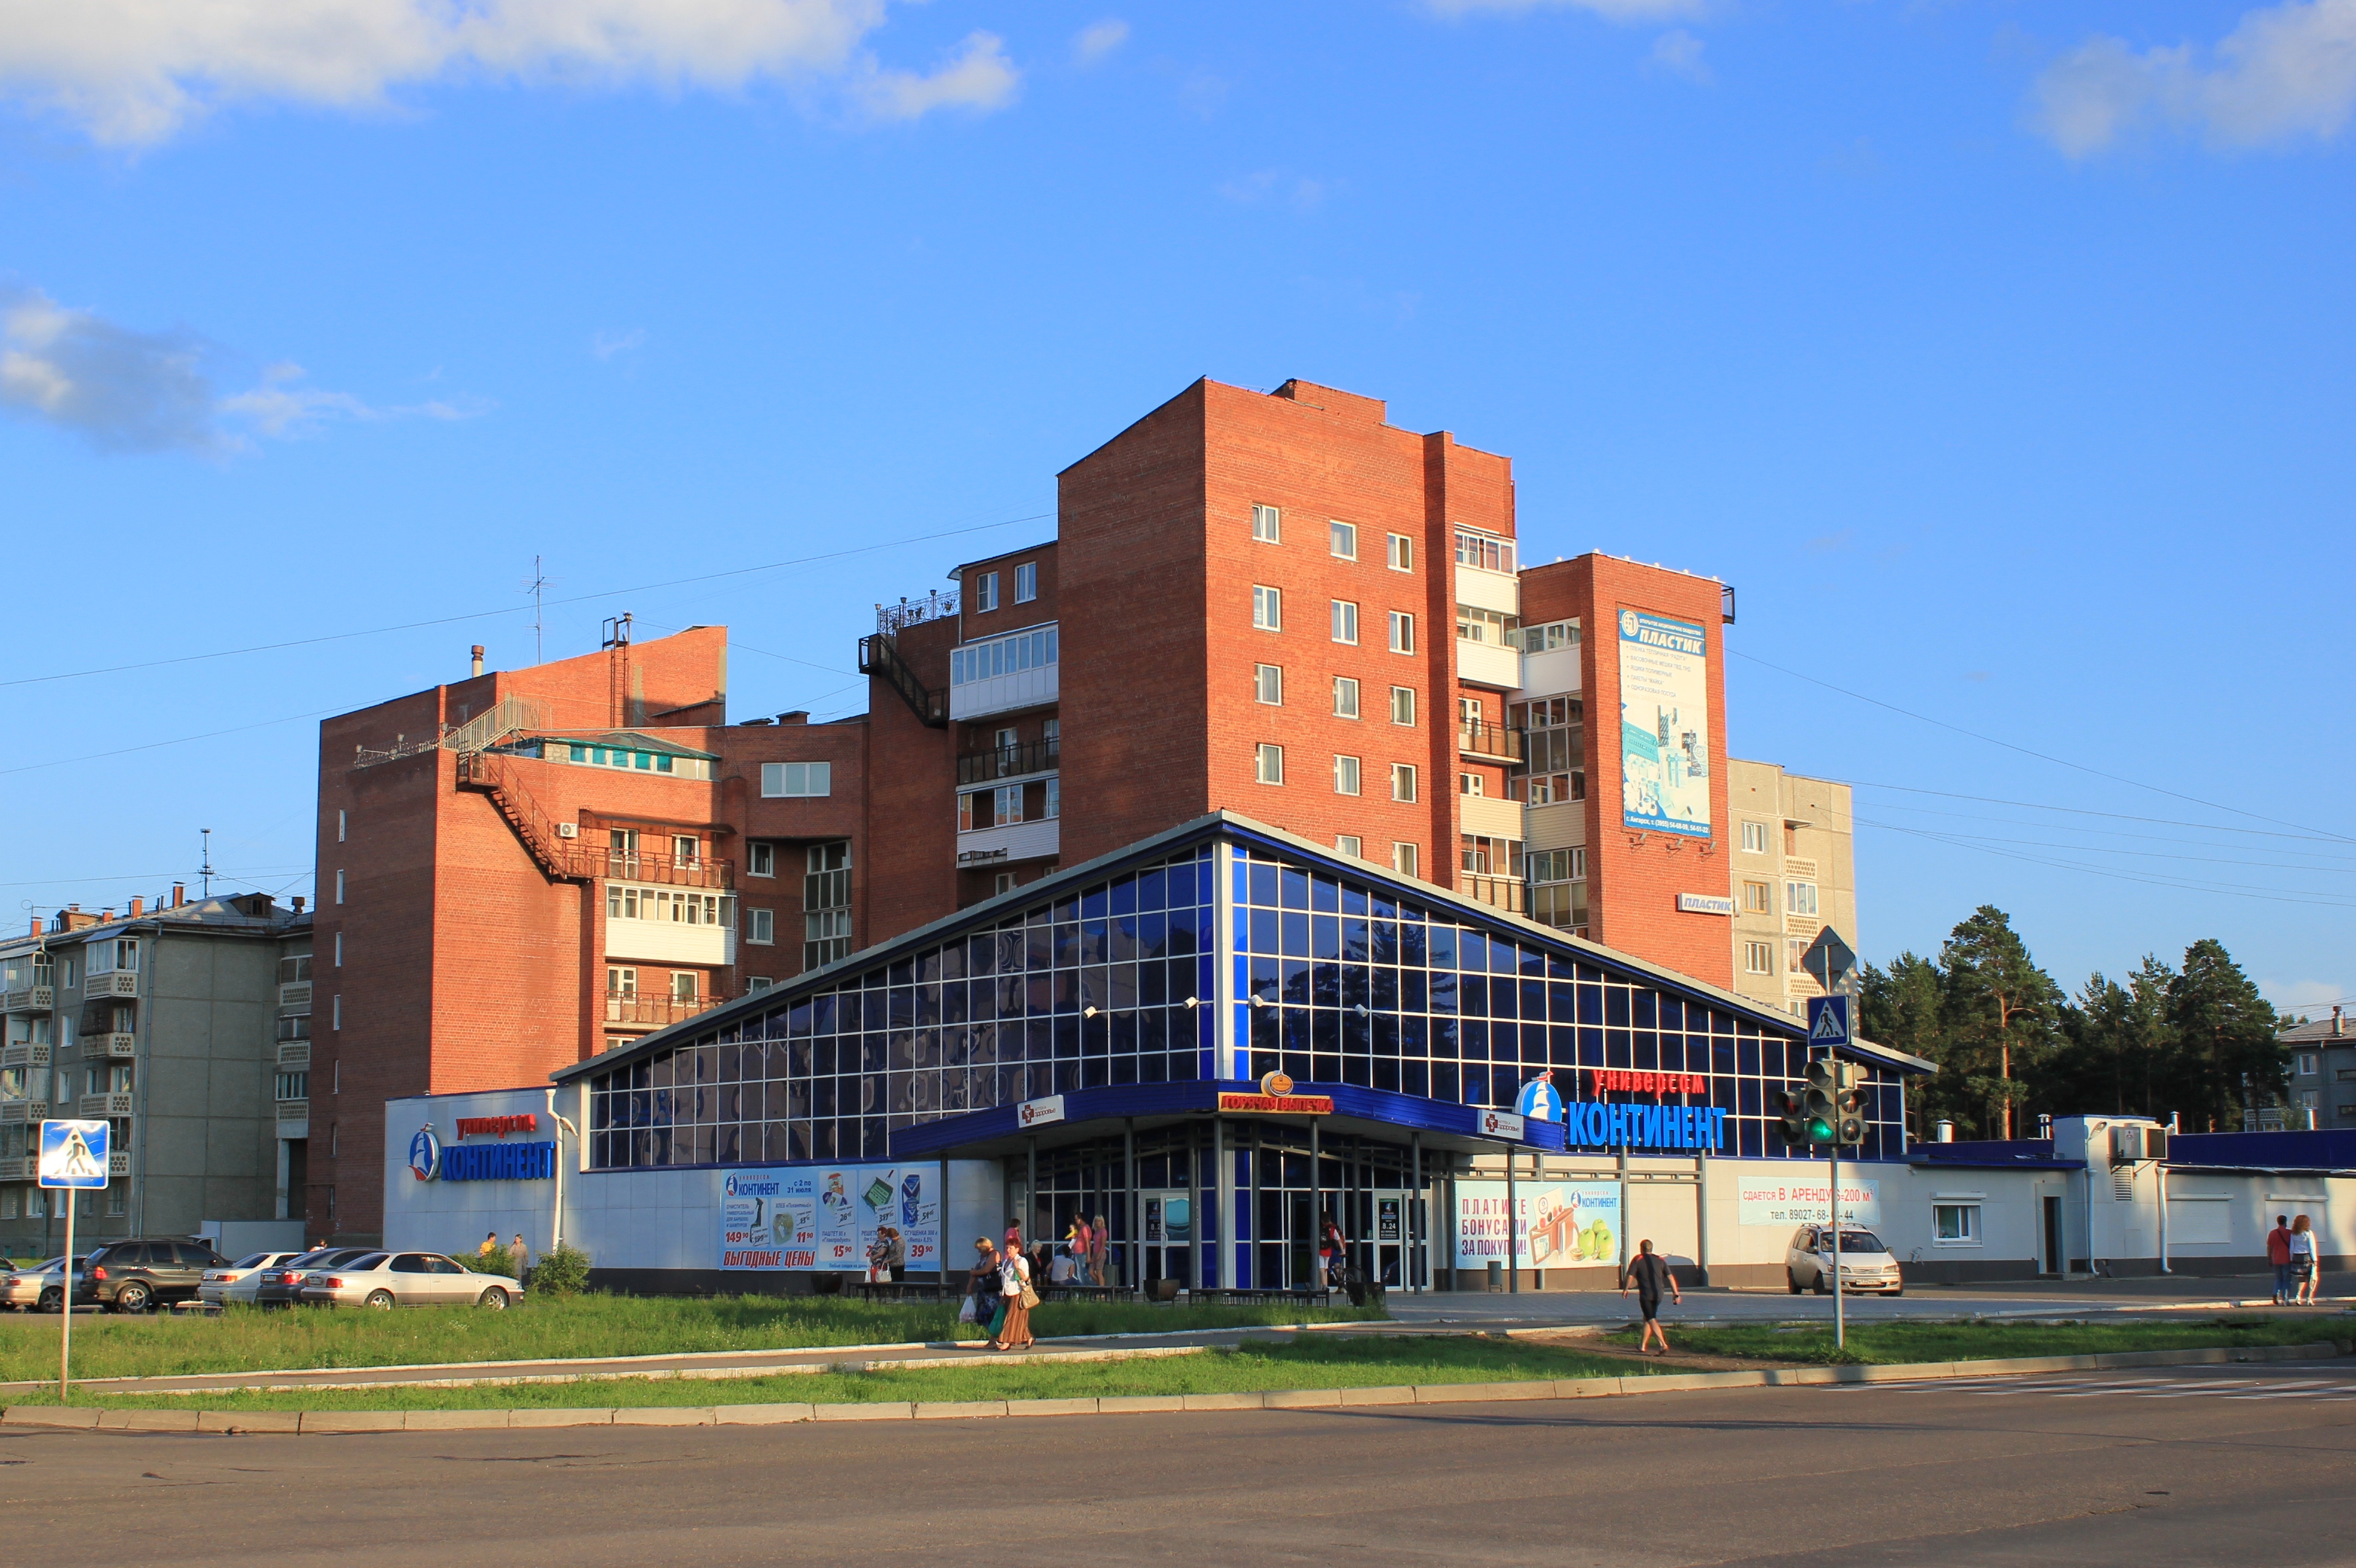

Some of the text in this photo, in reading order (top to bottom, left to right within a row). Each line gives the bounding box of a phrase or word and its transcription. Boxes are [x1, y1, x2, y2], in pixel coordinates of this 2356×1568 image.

[1639, 629, 1702, 654] ПЛАСТИК
[1684, 898, 1732, 911] ПЛАСТИК
[1221, 1095, 1334, 1111] ГОРЯЧАЯ ВЫПЕЧКА
[1569, 1101, 1726, 1149] КОНТИНЕНТ
[441, 1141, 556, 1181] КОНТИНЕНТ
[739, 1183, 780, 1196] КОНТИНЕНТ
[1743, 1190, 1776, 1201] СДАЕТСЯ
[1778, 1188, 1786, 1201] В
[1792, 1188, 1832, 1203] АРЕНДУ
[1462, 1199, 1527, 1215] ПЛАТИЕ
[1582, 1198, 1617, 1208] КОНТИНЕНТ
[1770, 1211, 1786, 1220] тел.
[725, 1232, 742, 1243] 149
[797, 1232, 806, 1243] 11
[833, 1245, 844, 1258] 15
[911, 1244, 924, 1258] 39
[1462, 1239, 1527, 1255] ЗА ПОКУПИ!
[723, 1250, 816, 1268] ВЫГОДНЫЕ ЦЕНЫ
